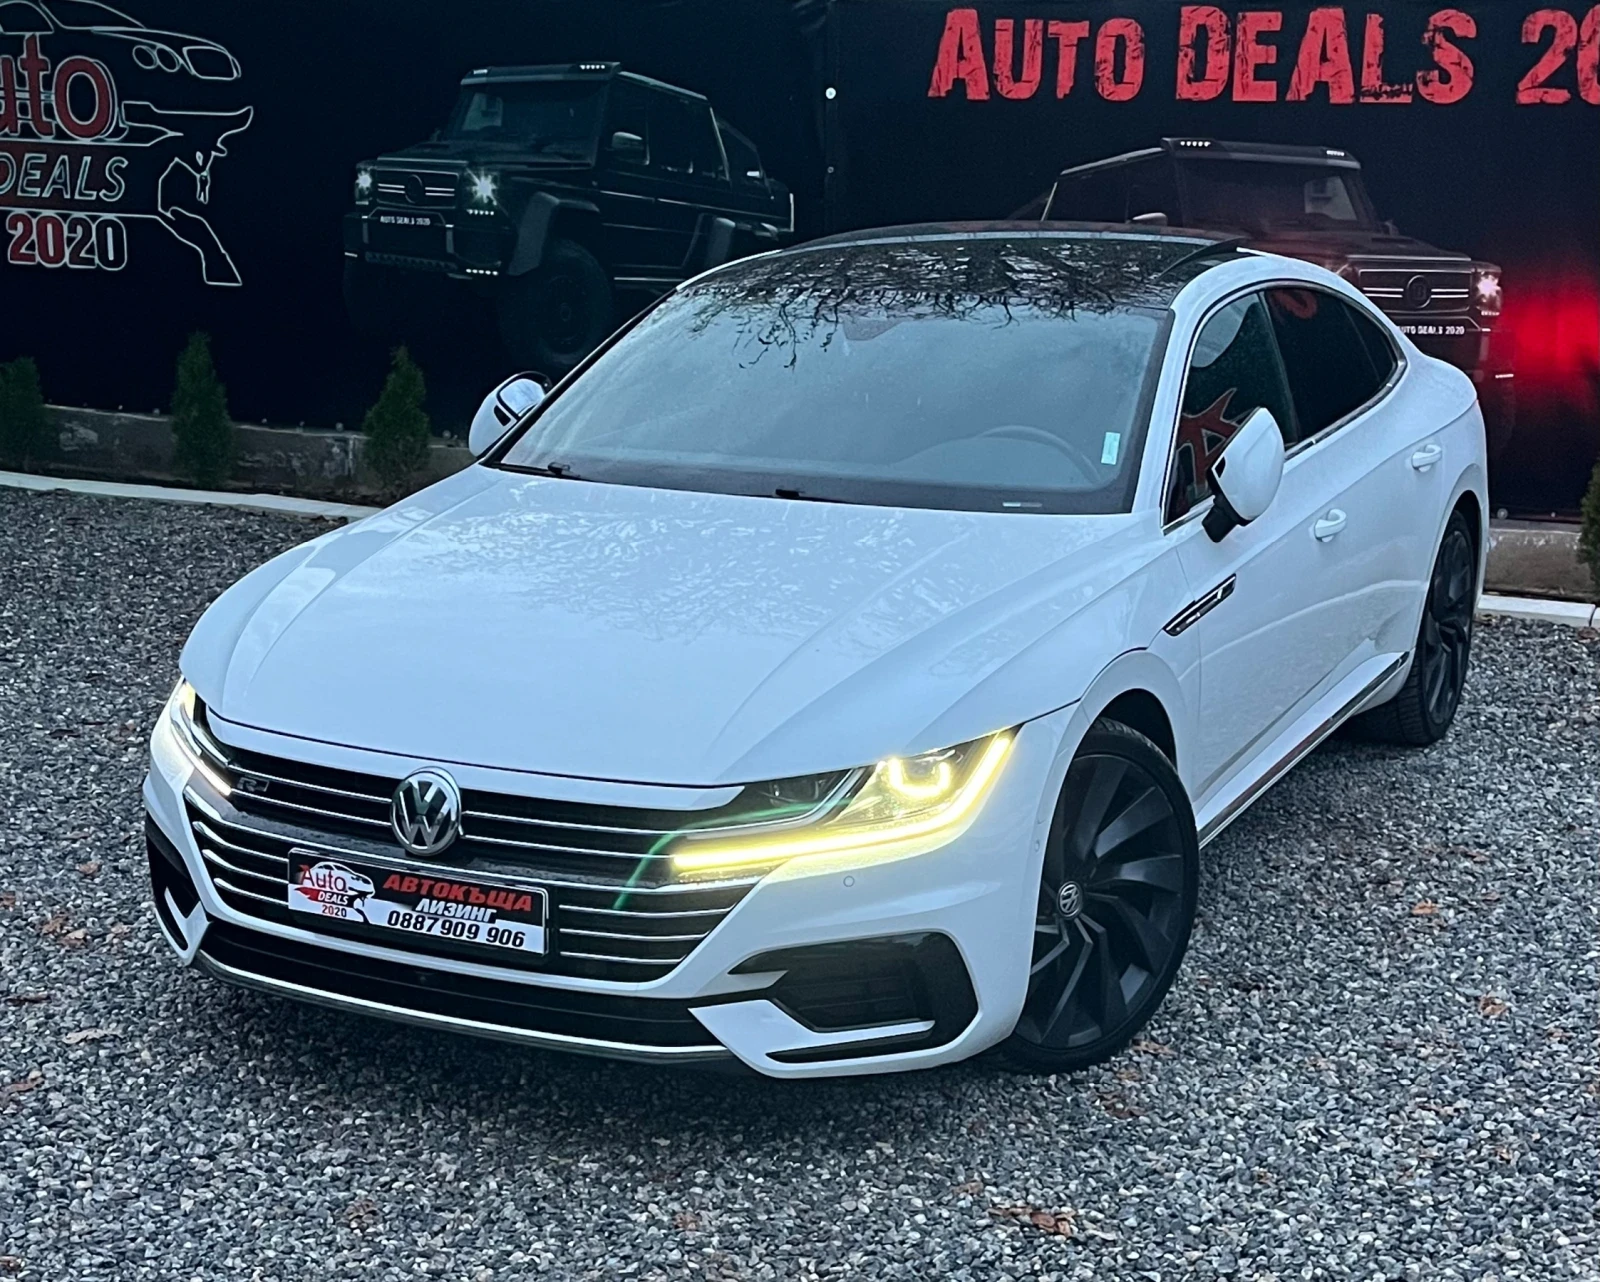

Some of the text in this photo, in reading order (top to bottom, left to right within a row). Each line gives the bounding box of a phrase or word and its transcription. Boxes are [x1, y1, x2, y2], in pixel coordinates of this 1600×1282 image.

[928, 7, 1144, 101] AUTO
[1175, 5, 1477, 104] DEALS
[6, 211, 128, 271] 2020
[1445, 325, 1465, 335] 2020
[299, 864, 348, 893] Auto
[382, 874, 532, 912] АВТОКЪЩА
[317, 890, 349, 906] DEALS
[321, 904, 348, 918] 2020
[415, 898, 498, 923] ЛИЗИНГ
[386, 910, 526, 948] 0887 909 906
